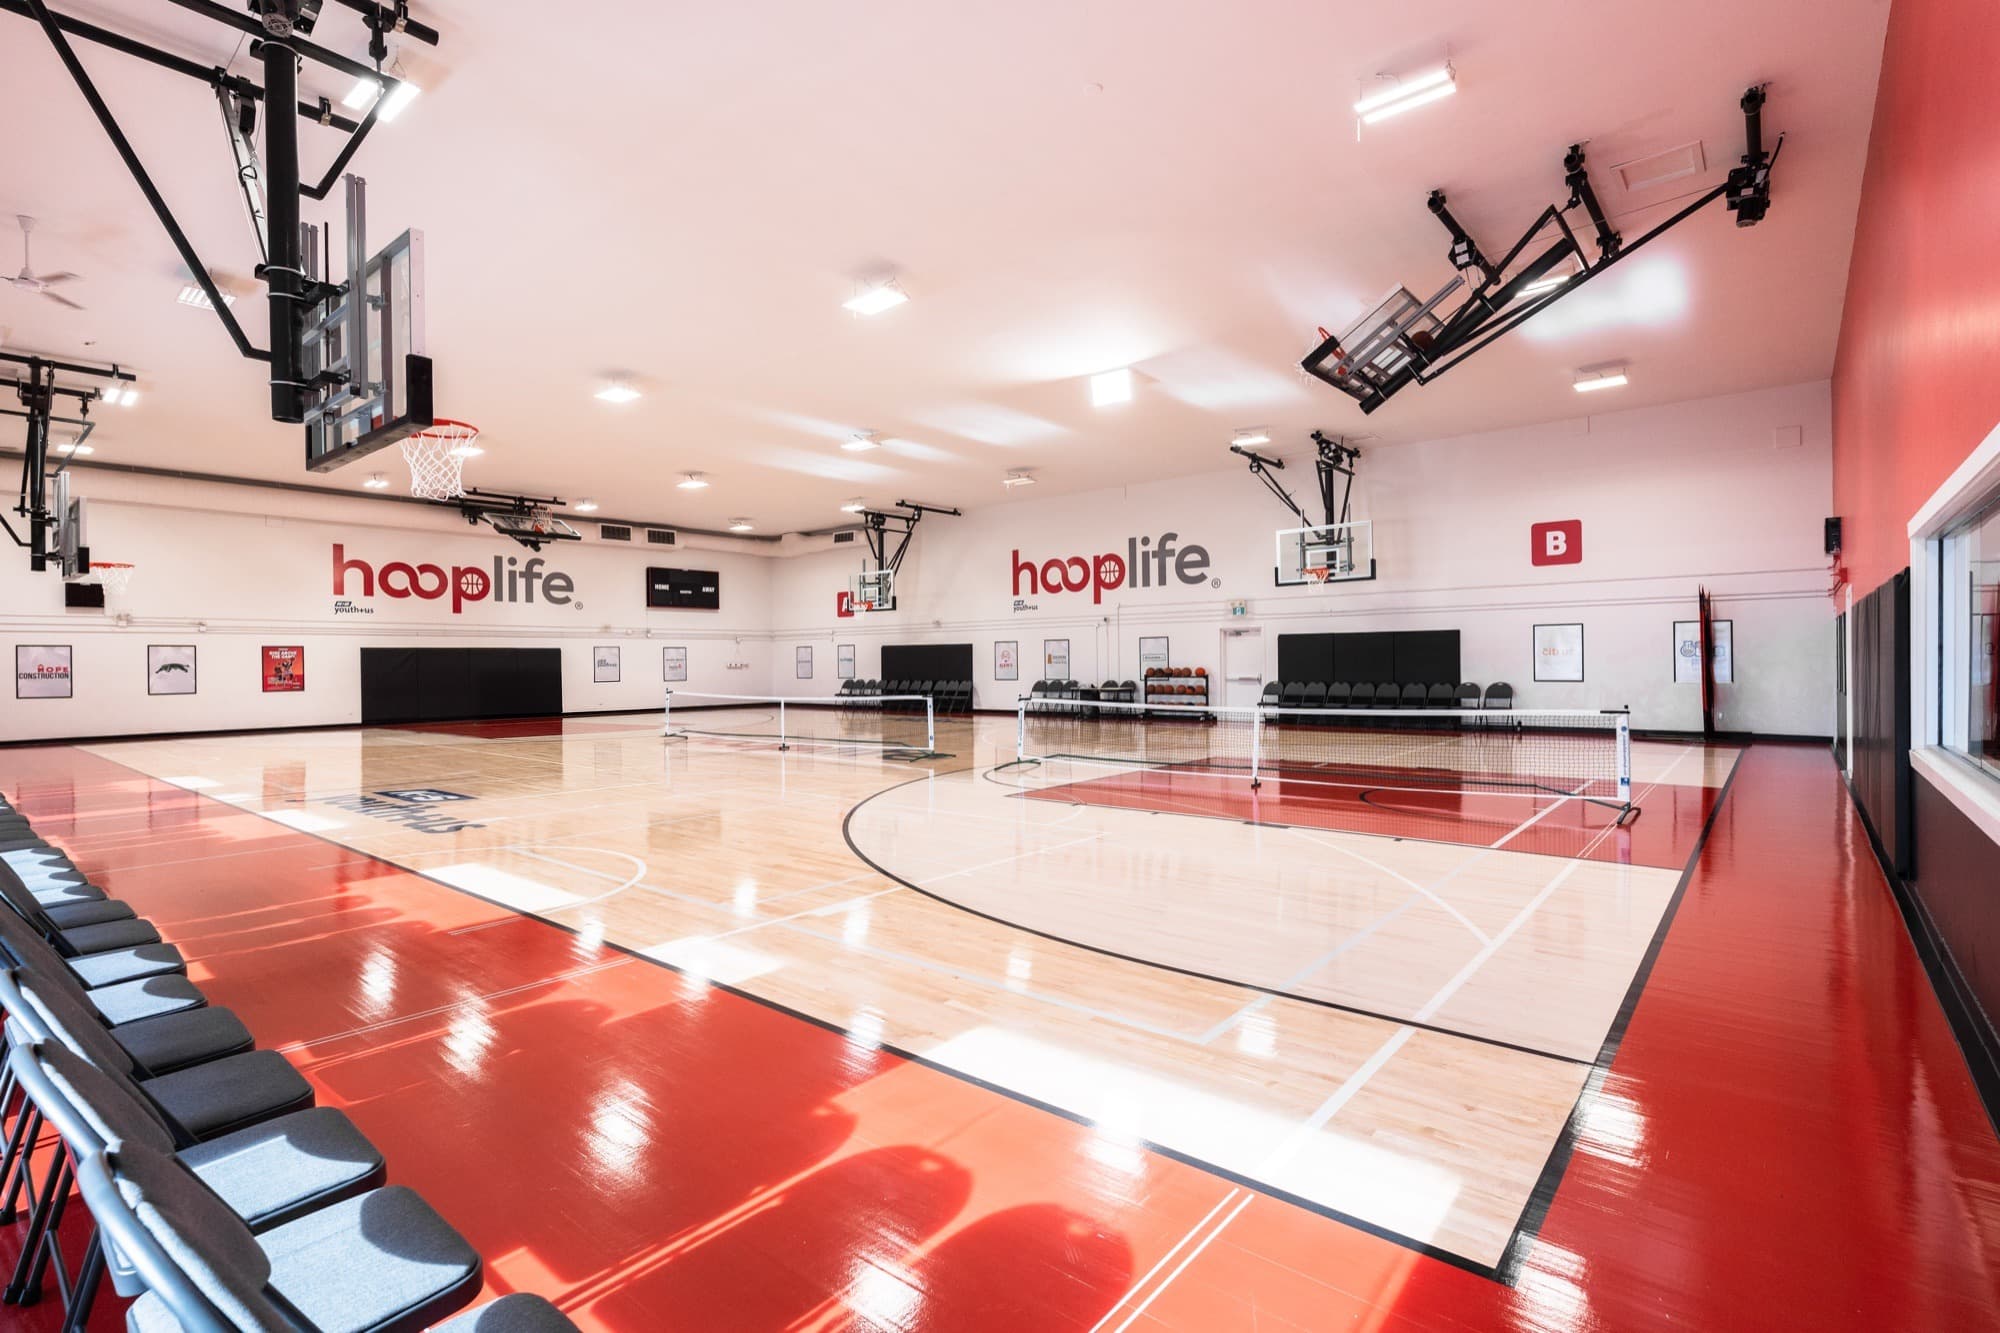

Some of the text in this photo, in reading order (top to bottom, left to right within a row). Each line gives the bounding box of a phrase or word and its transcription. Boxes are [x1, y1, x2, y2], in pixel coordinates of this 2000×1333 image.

[1546, 530, 1567, 556] B
[654, 583, 669, 591] HOME
[334, 606, 374, 615] youth+us
[37, 663, 69, 673] HOPE
[18, 672, 69, 680] CONSTRUCTION
